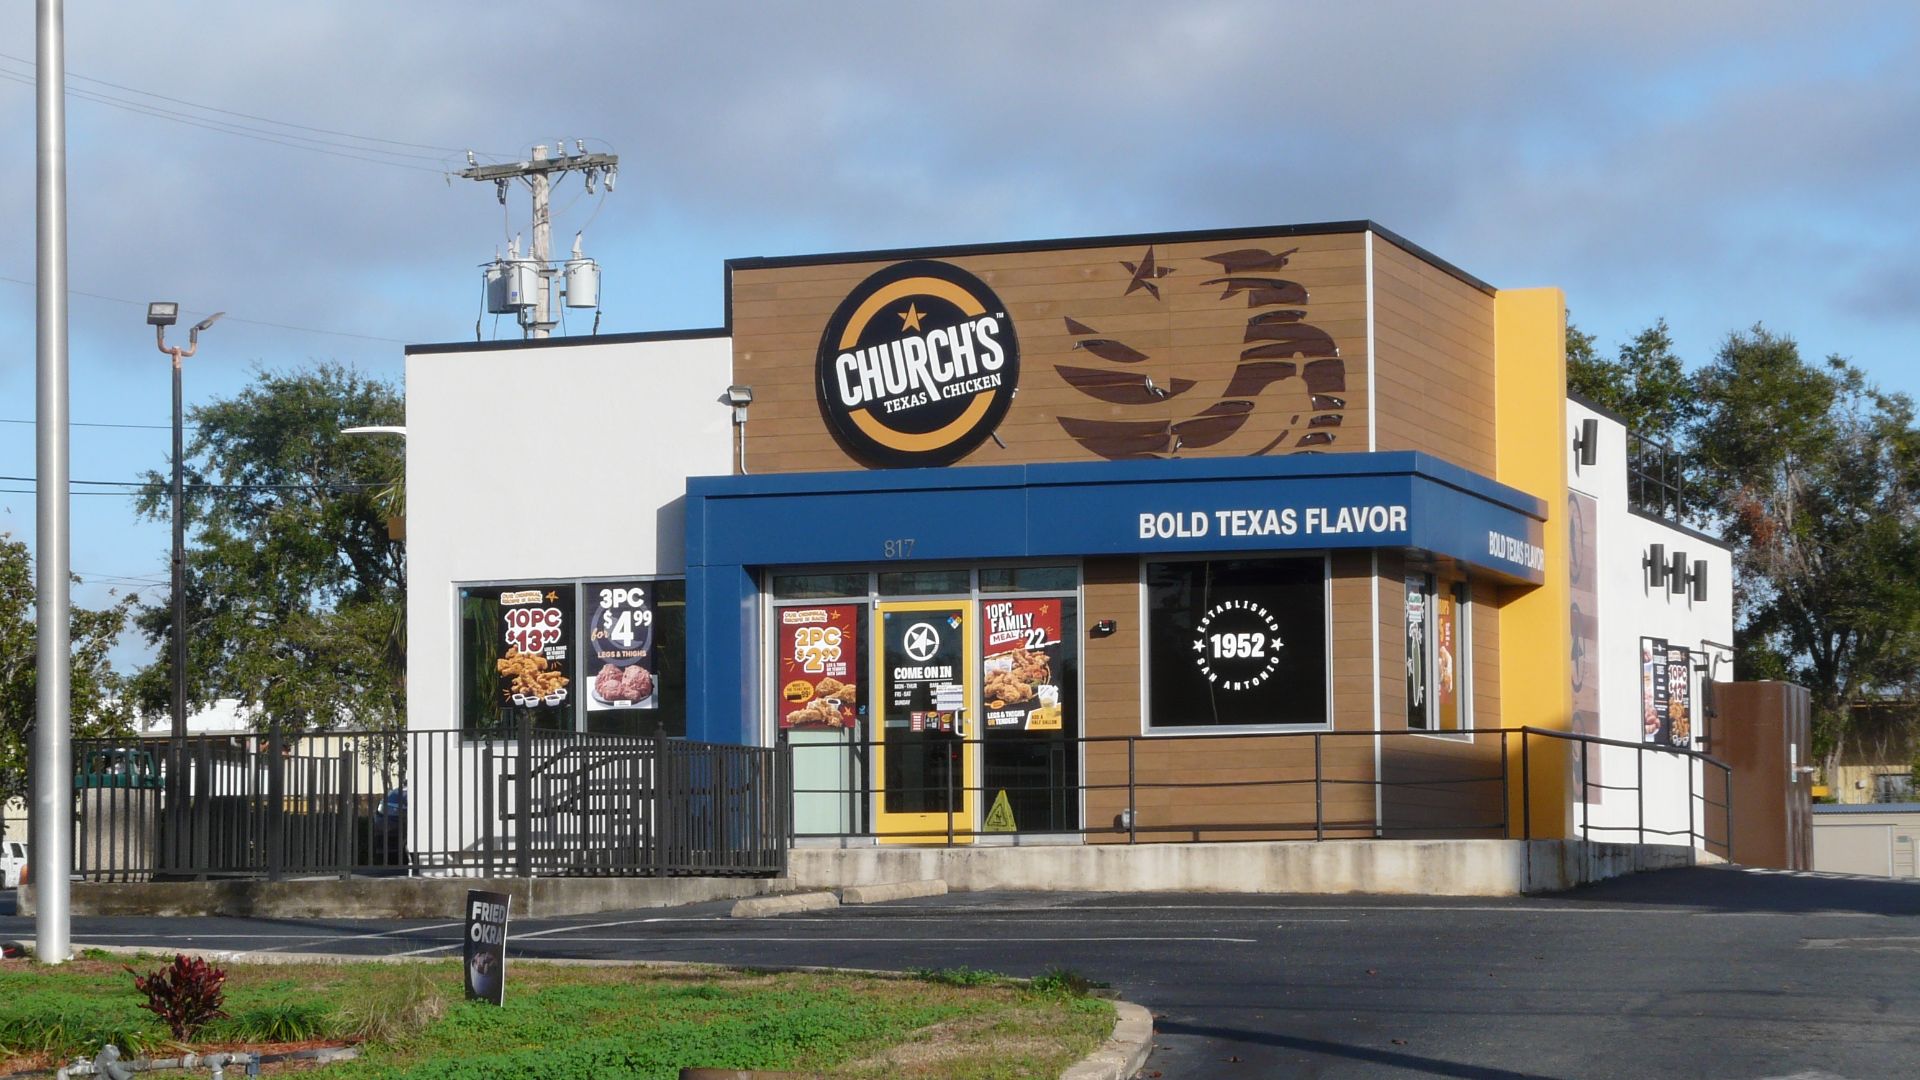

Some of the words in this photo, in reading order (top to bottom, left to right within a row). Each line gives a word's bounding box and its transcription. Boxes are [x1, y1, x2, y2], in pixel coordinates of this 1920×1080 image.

[835, 317, 1005, 406] CHURCH'S
[884, 392, 927, 413] TEXAS
[942, 373, 1002, 399] CHICKEN
[1139, 511, 1209, 539] BOLD
[1216, 508, 1298, 537] TEXAS
[1305, 506, 1407, 534] FLAVOR
[884, 538, 915, 560] 817
[1489, 530, 1506, 559] BOLD
[1506, 536, 1524, 566] TEXAS
[599, 588, 645, 609] 3PC
[505, 608, 561, 629] 10PC
[985, 602, 1013, 620] 10PC
[1197, 600, 1279, 633] ESTABLISHED
[991, 613, 1033, 633] FAMILY
[591, 628, 609, 642] for
[796, 628, 840, 647] 2PC
[992, 632, 1017, 643] MEAL
[1210, 632, 1265, 658] 1952
[597, 650, 615, 659] LEGS
[616, 650, 621, 658] &
[621, 649, 647, 658] THIGHS
[894, 667, 924, 679] COME
[924, 666, 939, 679] ON
[939, 665, 952, 678] IN
[1197, 657, 1218, 682] SAN
[1223, 656, 1280, 691] ANTONIO
[1668, 665, 1688, 681] 10PC
[987, 711, 1001, 719] LEGS
[1005, 710, 1025, 718] THIGHS
[996, 717, 1019, 725] TENDERS
[471, 901, 506, 924] FRIED
[470, 922, 503, 945] OKRA
